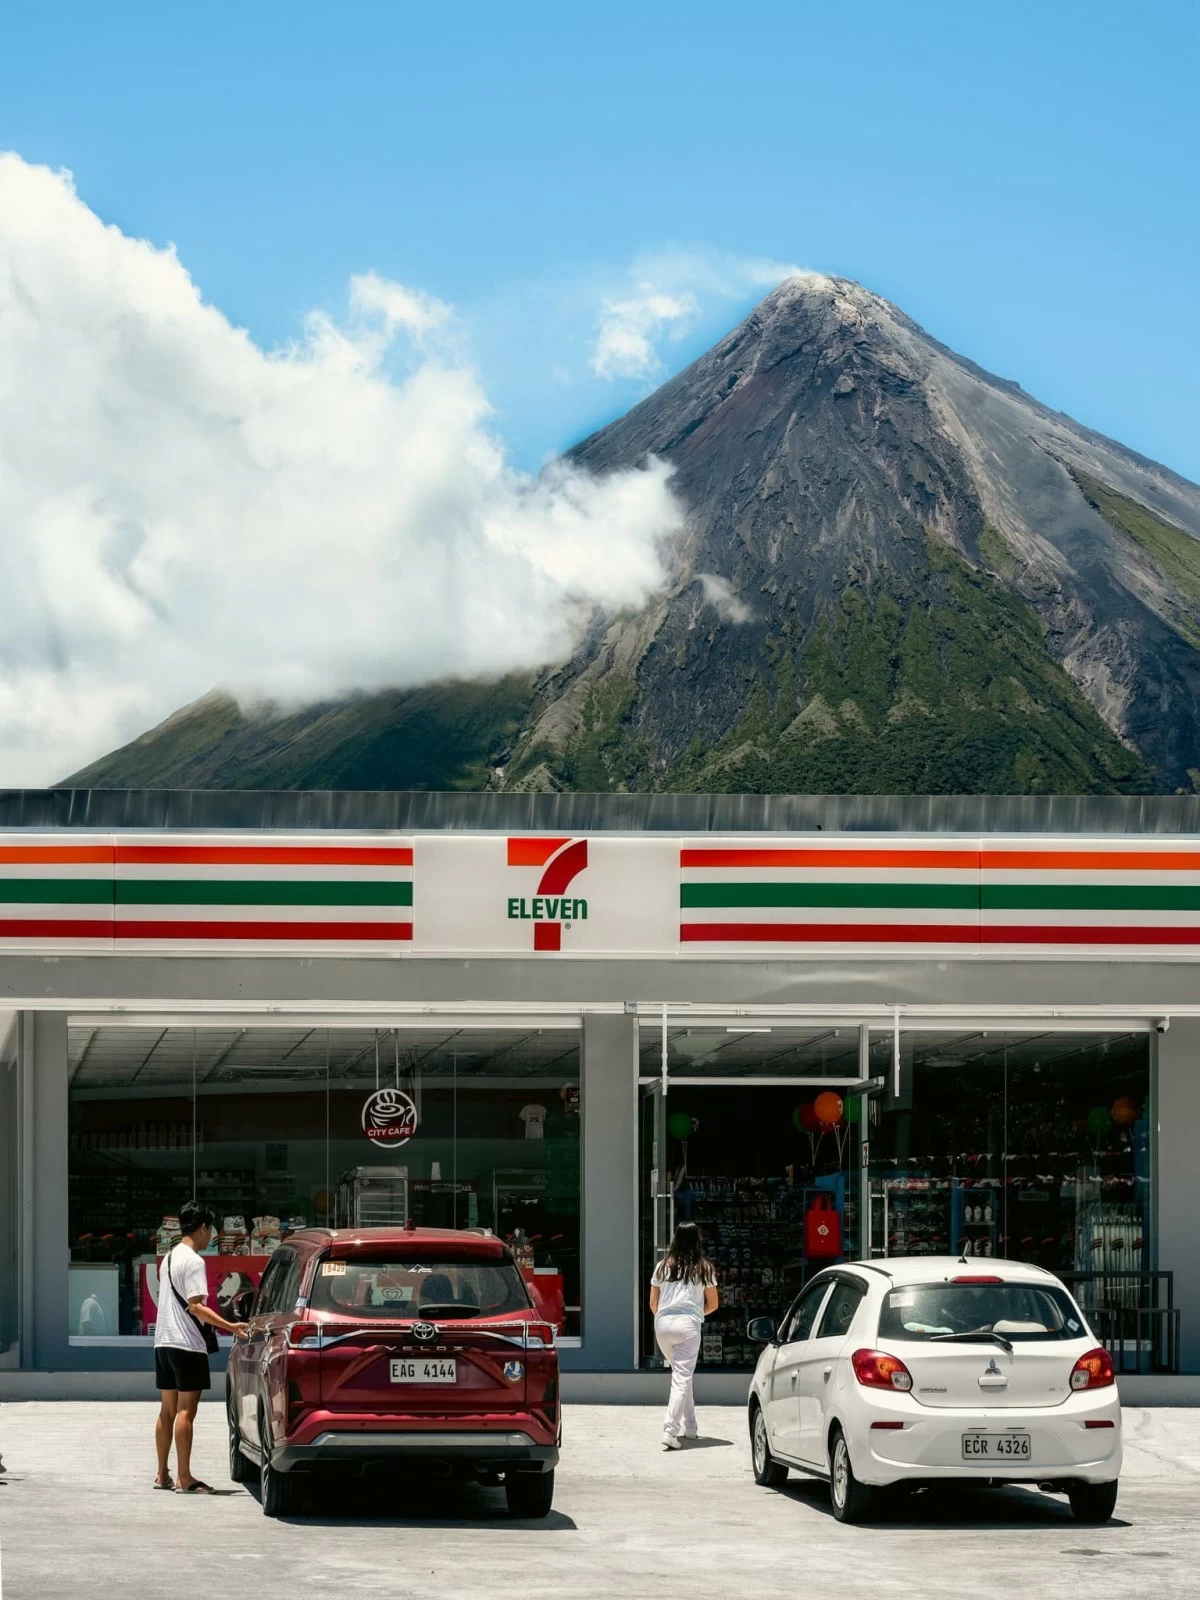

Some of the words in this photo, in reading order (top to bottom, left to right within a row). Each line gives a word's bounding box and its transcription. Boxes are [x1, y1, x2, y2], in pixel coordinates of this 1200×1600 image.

[507, 838, 588, 951] 7
[367, 1129, 387, 1137] CITY
[388, 1127, 411, 1135] CAFE
[392, 1364, 415, 1378] EAG
[423, 1364, 455, 1378] 4144
[964, 1440, 988, 1454] ECR
[997, 1440, 1028, 1454] 4326
